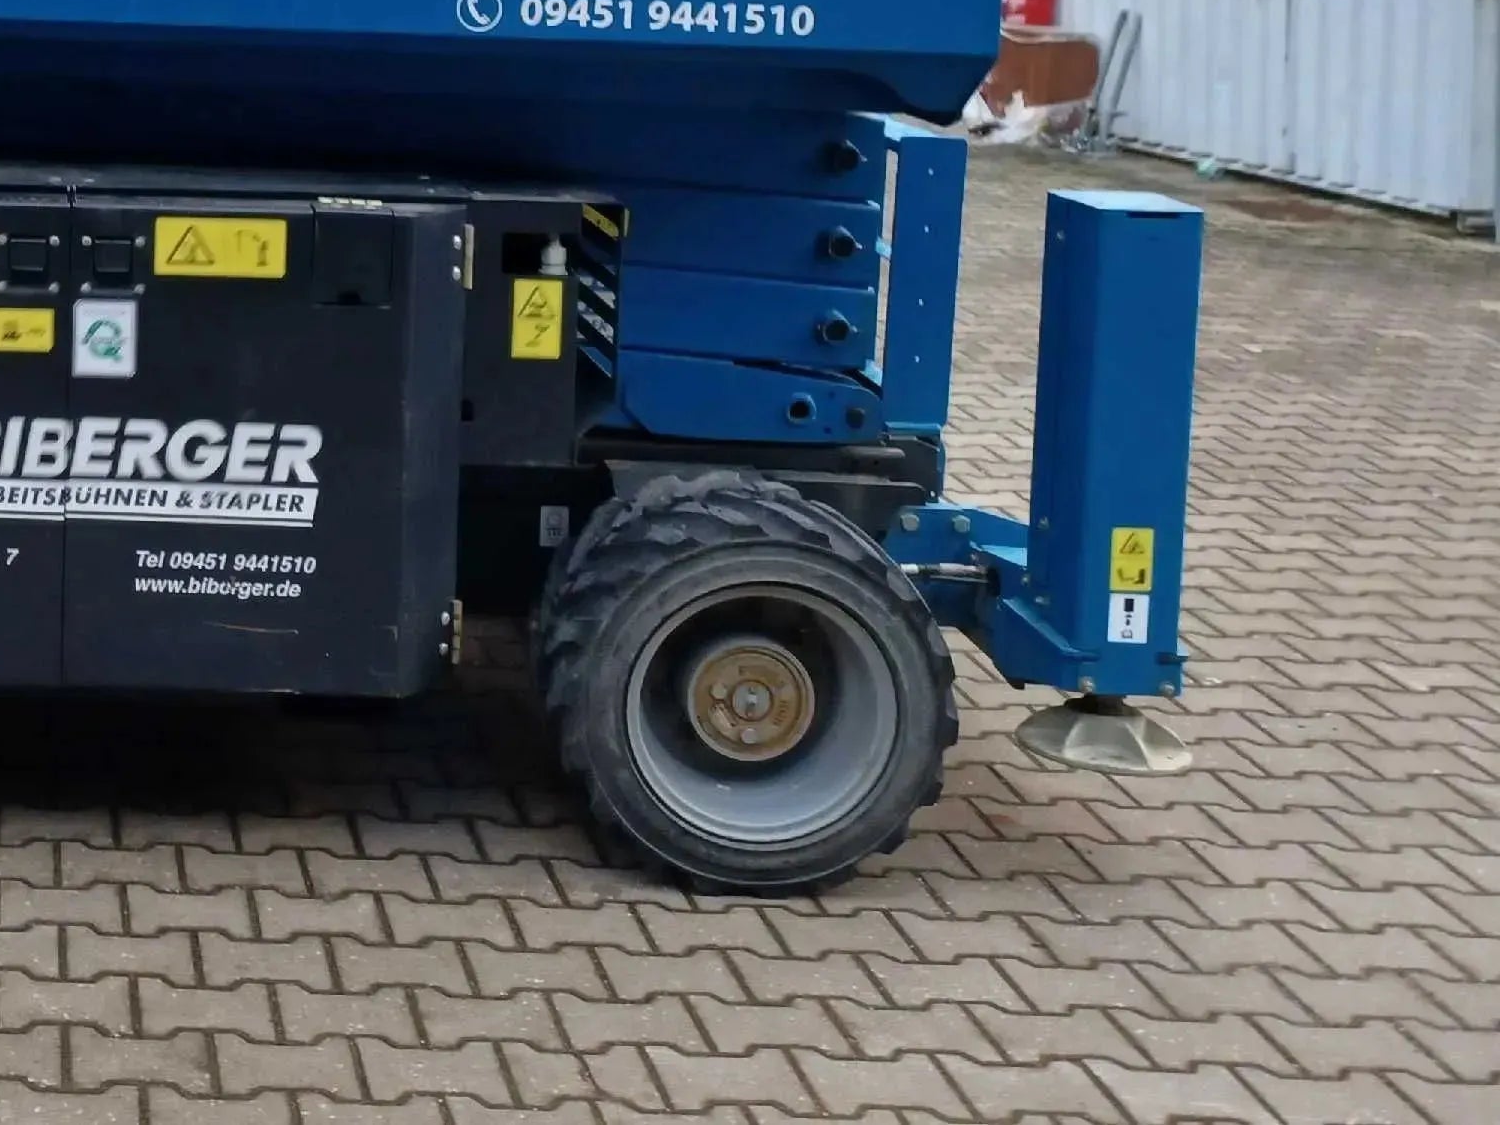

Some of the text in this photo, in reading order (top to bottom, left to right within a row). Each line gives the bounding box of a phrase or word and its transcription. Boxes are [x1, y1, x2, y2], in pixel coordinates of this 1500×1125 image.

[647, 0, 815, 36] 9441510
[175, 491, 193, 509] &
[199, 491, 304, 513] STAPLER
[6, 547, 19, 566] 7
[135, 550, 317, 574] Tel 09451 9441510
